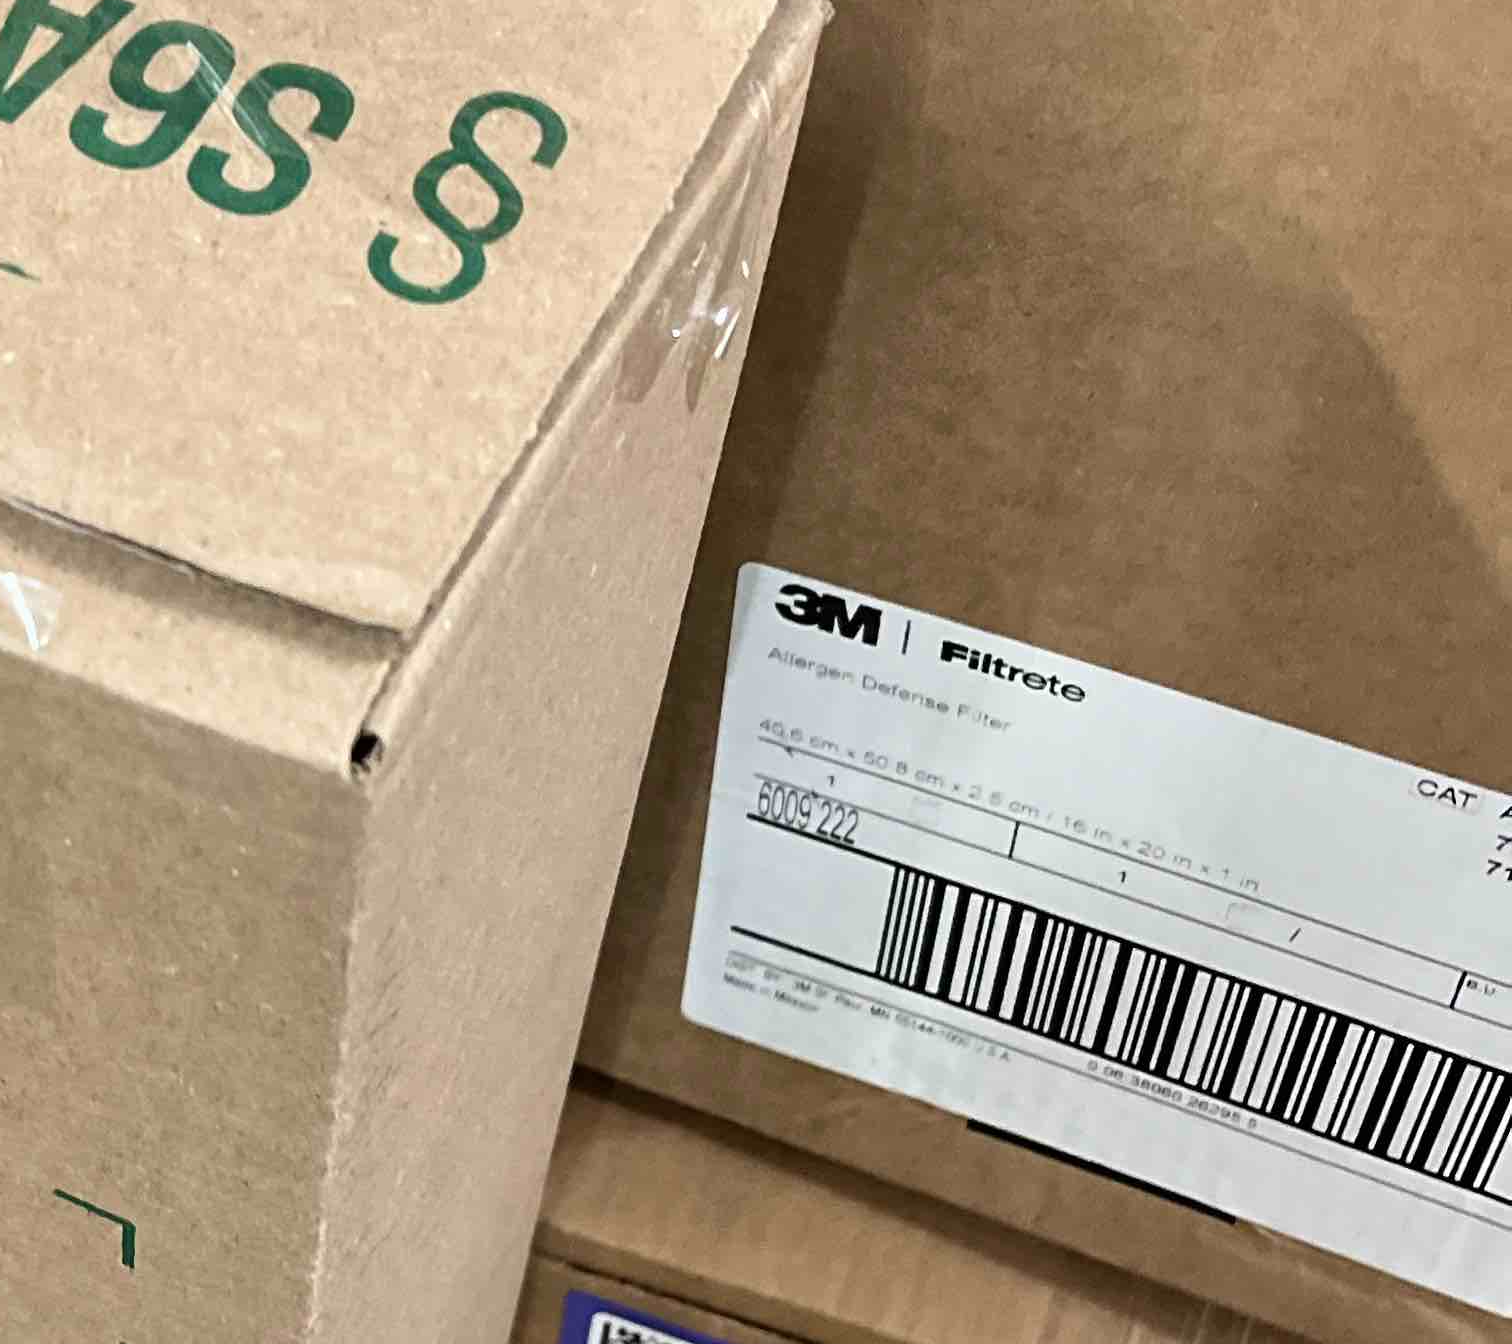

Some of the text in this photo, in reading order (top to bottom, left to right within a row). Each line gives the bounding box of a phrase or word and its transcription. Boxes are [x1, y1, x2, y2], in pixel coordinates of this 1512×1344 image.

[775, 584, 1086, 703] 3M Filtrete
[767, 646, 1014, 734] Allergen Defense Filter
[758, 782, 859, 845] 6009 222
[809, 734, 840, 753] cm
[914, 768, 945, 789] cm
[1008, 798, 1040, 818] cm
[1138, 841, 1167, 860] 20
[1417, 779, 1477, 808] CAT
